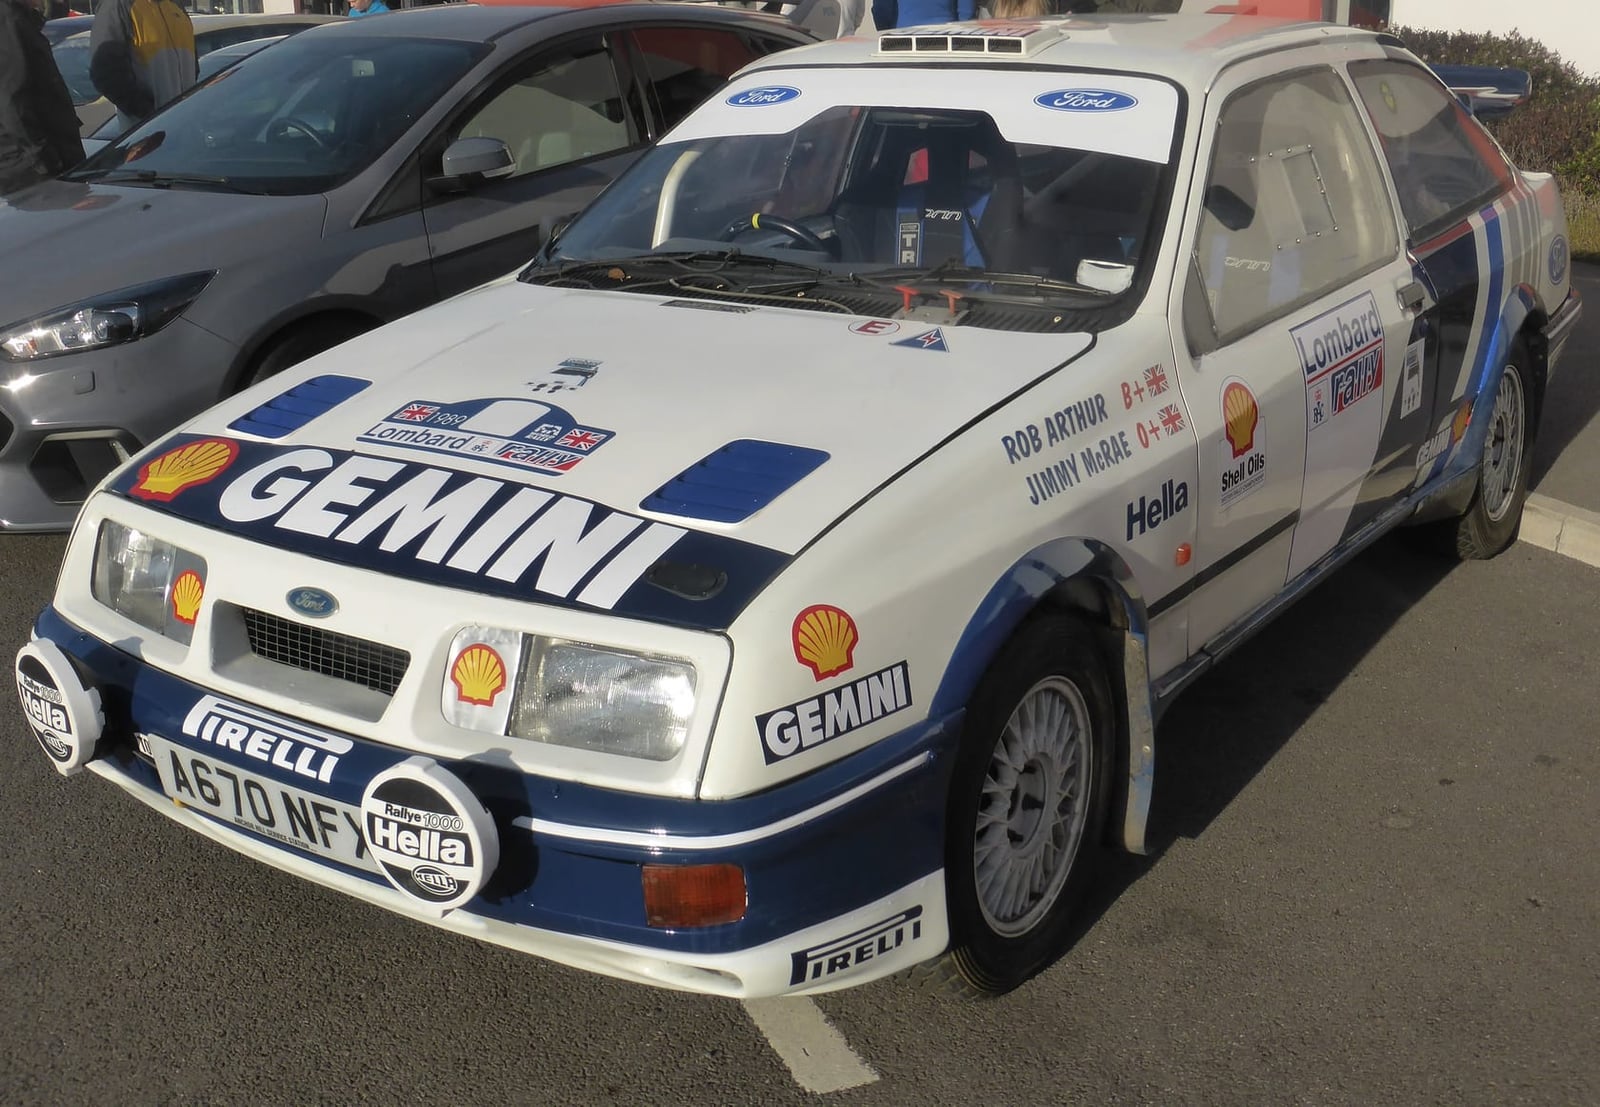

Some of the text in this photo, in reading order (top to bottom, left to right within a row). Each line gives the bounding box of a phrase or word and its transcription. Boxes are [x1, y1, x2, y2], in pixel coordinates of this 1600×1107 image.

[855, 320, 893, 334] E
[1298, 300, 1382, 375] Lombard
[1332, 349, 1382, 412] rally
[364, 423, 476, 449] Lombard
[427, 412, 468, 425] 1989
[1001, 381, 1145, 464] ROB ARTHUR B+
[498, 442, 578, 469] rally
[1026, 453, 1081, 505] JIMMY
[1080, 431, 1132, 477] McRAE
[1222, 462, 1245, 492] Shell
[1247, 453, 1265, 476] Oils
[219, 448, 688, 610] GEMINI
[1126, 479, 1188, 542] Hella
[21, 685, 67, 732] Hella
[182, 694, 354, 783] PIRELLI
[765, 665, 907, 756] GEMINI
[170, 750, 276, 828] A670
[385, 803, 464, 831] Rallye 1000
[374, 817, 466, 865] Hella
[416, 873, 457, 889] HELLA
[789, 904, 923, 986] PIRELLI
